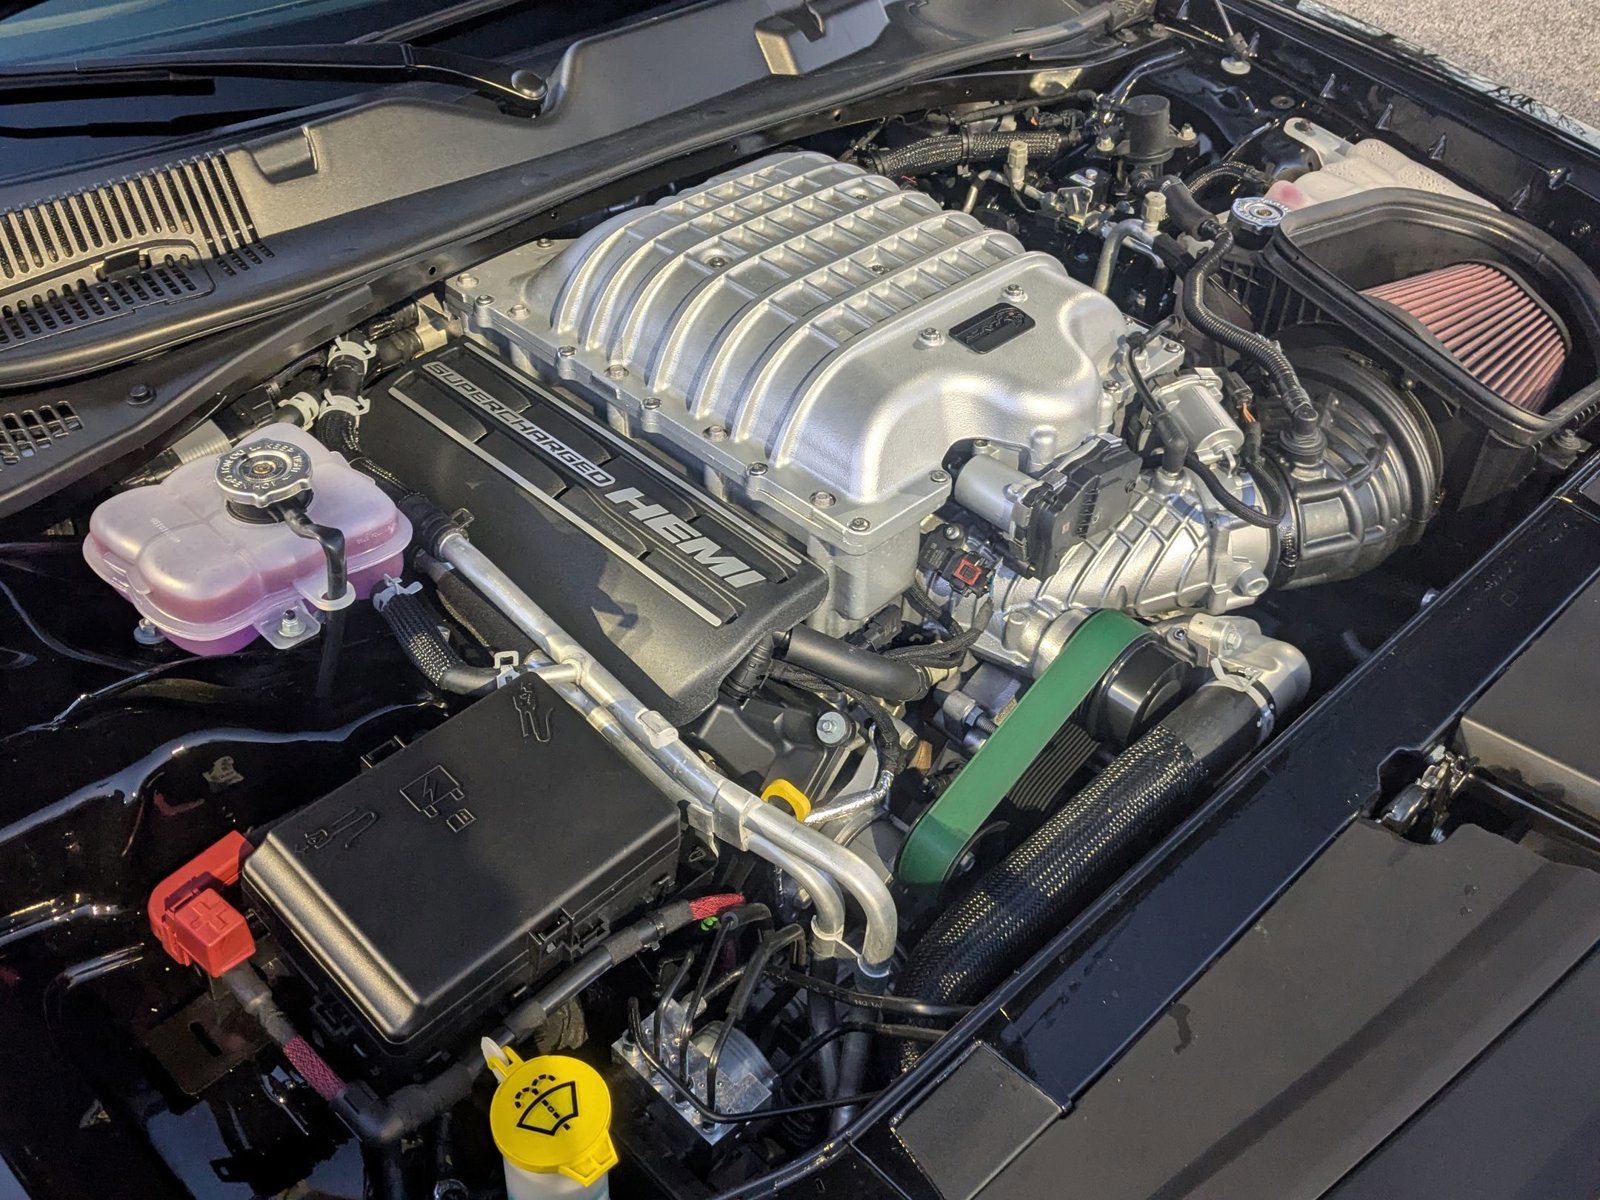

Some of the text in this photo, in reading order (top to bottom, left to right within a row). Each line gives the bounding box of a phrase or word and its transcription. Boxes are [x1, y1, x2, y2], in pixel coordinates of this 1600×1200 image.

[230, 449, 246, 459] DO
[253, 481, 277, 490] HOT
[424, 362, 766, 588] SUPERCHARGED HEMI
